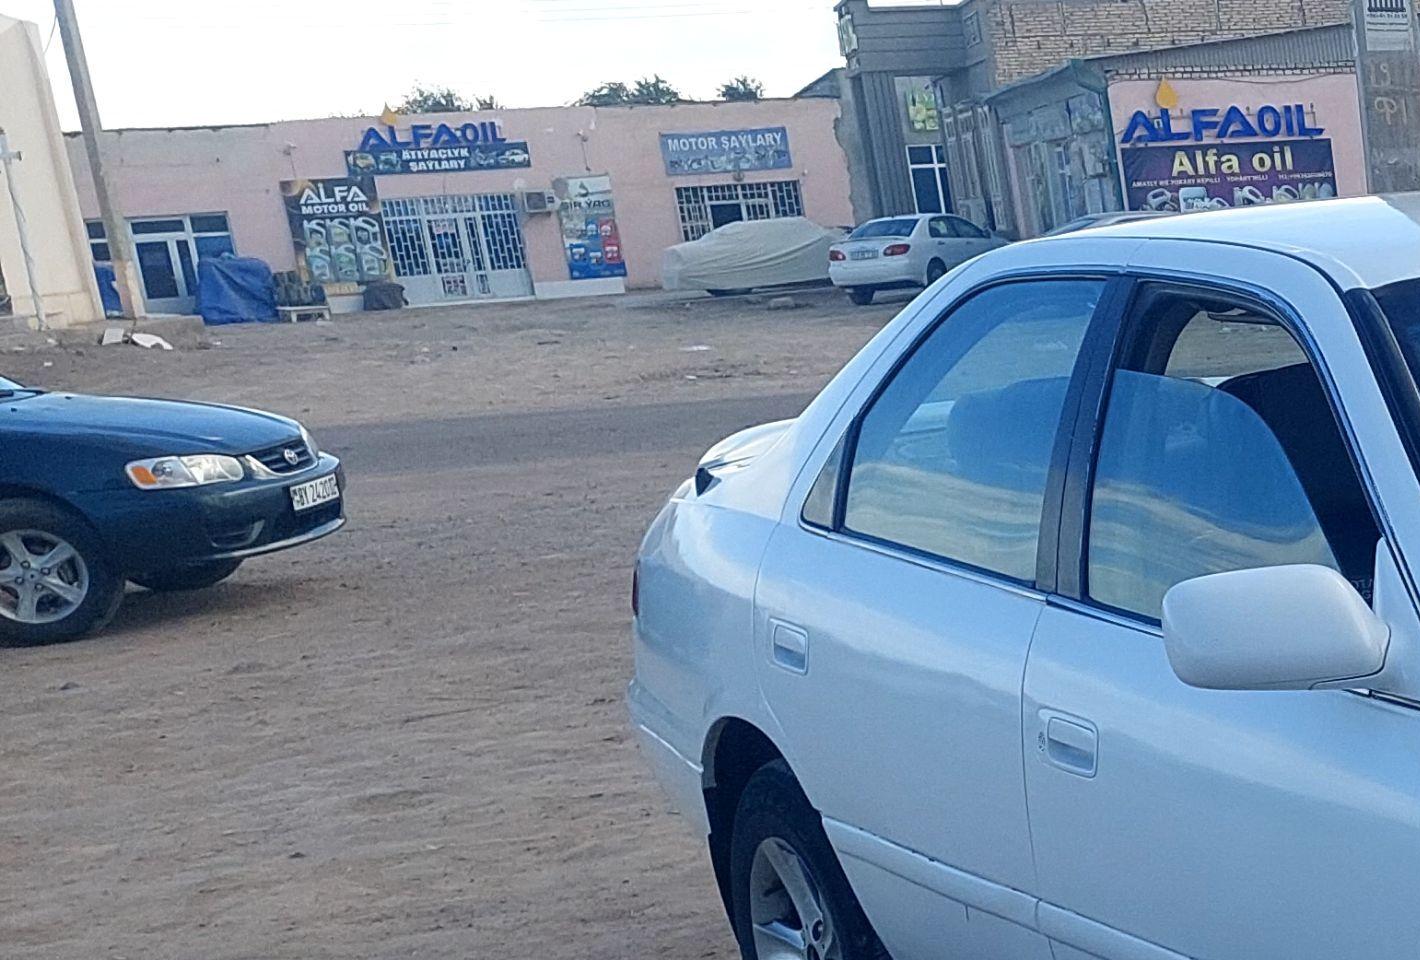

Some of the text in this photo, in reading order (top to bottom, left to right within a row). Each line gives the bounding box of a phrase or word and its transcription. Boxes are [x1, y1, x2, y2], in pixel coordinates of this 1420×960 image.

[667, 136, 718, 152] MOTOR
[1171, 145, 1293, 177] Alfa oil
[299, 182, 368, 205] ALFA
[301, 202, 370, 215] MOTOR OIL
